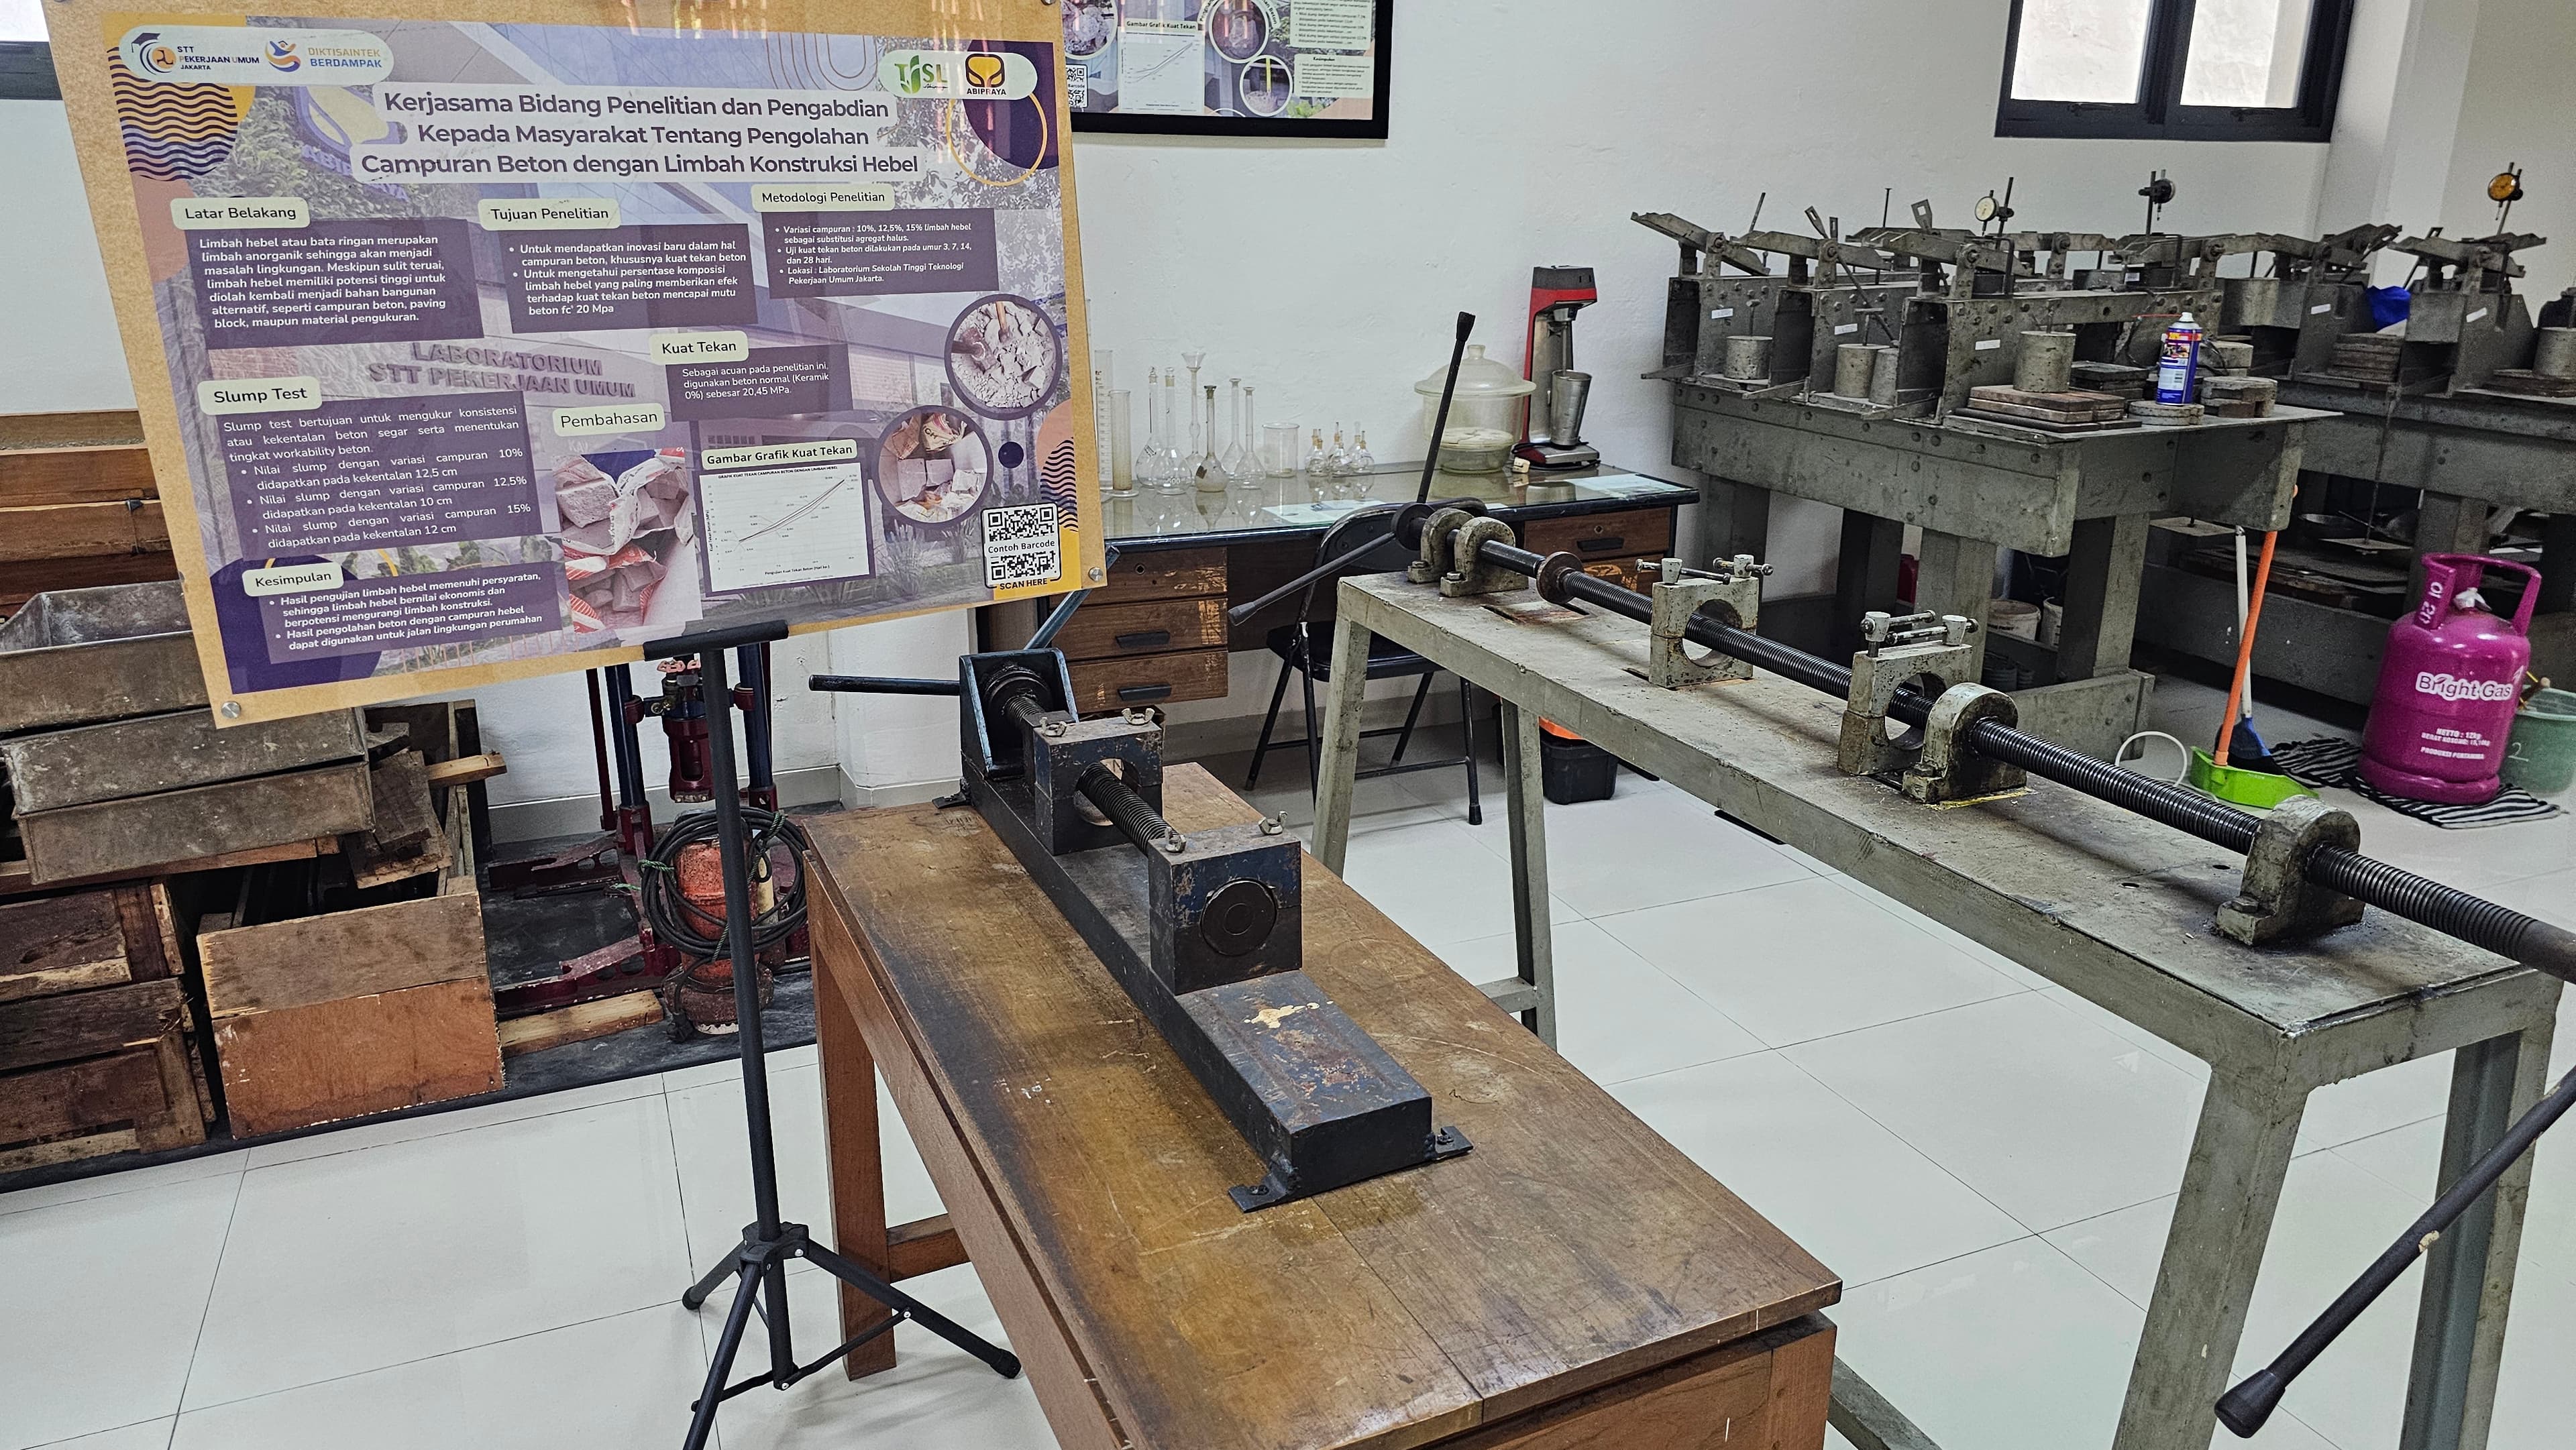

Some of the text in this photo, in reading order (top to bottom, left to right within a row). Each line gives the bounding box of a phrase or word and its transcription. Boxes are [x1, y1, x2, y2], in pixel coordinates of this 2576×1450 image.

[307, 46, 381, 58] DIKTISAINTEK
[179, 56, 260, 64] PEKERJAAN UMUM
[310, 58, 382, 68] BERDAMPAK
[384, 91, 889, 120] Kerjasama Bidang Penelitian dan Pengabdian
[418, 124, 869, 148] Kepada Masyarakat Tentang Pengolahan
[361, 154, 492, 177] Campuran
[496, 155, 568, 172] Beton
[573, 154, 659, 176] dengan
[664, 154, 745, 172] Limbah
[749, 154, 857, 172] Konstruksi
[862, 155, 918, 172] Hebel
[762, 191, 885, 204] Metodologi Penelitian
[185, 207, 296, 220] Latar Belakang
[490, 207, 608, 222] Tujuan Penelitian
[783, 225, 810, 233] Variasi
[906, 223, 923, 231] 15%
[924, 223, 949, 231] limbah
[199, 235, 438, 248] Limbah hebel atau bata ringan merupakan
[520, 240, 736, 254] Untuk mendapatkan inovasi baru dalam hal
[202, 247, 432, 262] limbah anorganik sehingga akan menjadi
[521, 252, 746, 268] campuran beton, khususnya kuat tekan beton
[786, 256, 802, 264] dan
[815, 256, 832, 264] hari.
[204, 264, 254, 275] masalah
[257, 264, 324, 276] lingkungan.
[327, 262, 380, 273] Meskipun
[382, 260, 408, 271] sulit
[788, 266, 812, 274] Lokasi
[818, 264, 869, 274] Laboratorium
[871, 264, 902, 272] Sekolah
[902, 263, 926, 272] Tinggi
[928, 262, 963, 271] Teknologi
[788, 274, 884, 285] Pekerjaan Umum Jakarta.
[529, 306, 559, 315] beton
[576, 304, 590, 313] 20
[592, 304, 614, 315] Mpa
[662, 341, 737, 354] Kuat Tekan
[413, 342, 602, 376] LABORATORIUM
[682, 368, 718, 378] Sebagai
[749, 364, 770, 375] pada
[772, 362, 814, 374] penelitian
[368, 364, 635, 397] STT PEKERJAAN UMUM
[683, 372, 829, 389] digunakan beton normal (Keramik
[213, 388, 308, 404] Slump Test
[684, 390, 703, 400] 0%)
[706, 389, 741, 398] sebesar
[223, 405, 517, 432] Slump test bertujuan untuk mengukur konsistensi
[561, 412, 657, 428] Pembahasan
[229, 445, 373, 463] tingkat workability beton.
[707, 445, 852, 464] Gambar Grafik Kuat Tekan
[987, 539, 1055, 553] Contoh Barcode
[255, 572, 331, 587] Kesimpulan
[1000, 577, 1048, 590] SCAN HERE
[280, 573, 541, 606] Hasil pengujian limbah hebel memenuhi persyaratan,
[2419, 675, 2512, 698] Bright Gas
